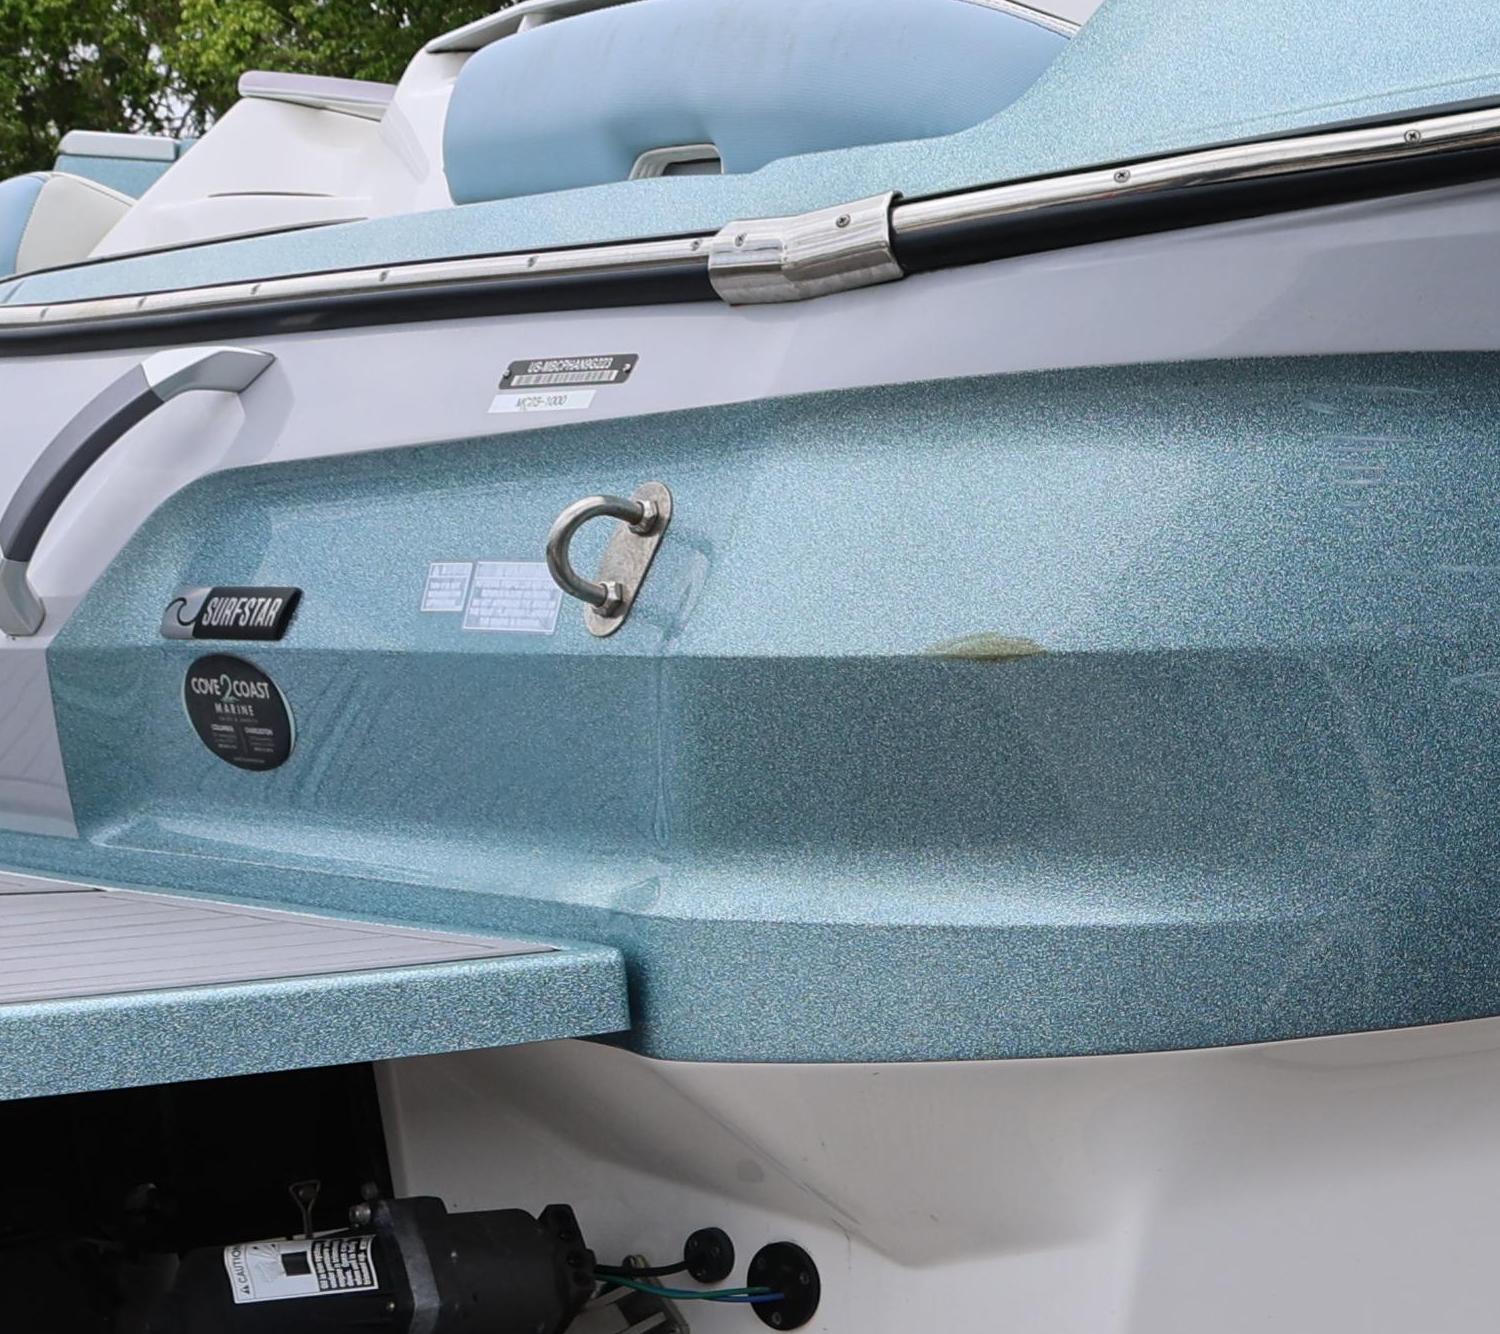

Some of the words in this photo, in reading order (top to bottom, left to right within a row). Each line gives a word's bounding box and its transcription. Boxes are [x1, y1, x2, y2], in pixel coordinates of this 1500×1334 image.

[202, 597, 283, 627] SURFSTAR
[191, 677, 221, 696] COVE
[233, 680, 270, 700] COAST
[214, 703, 253, 716] MARINE
